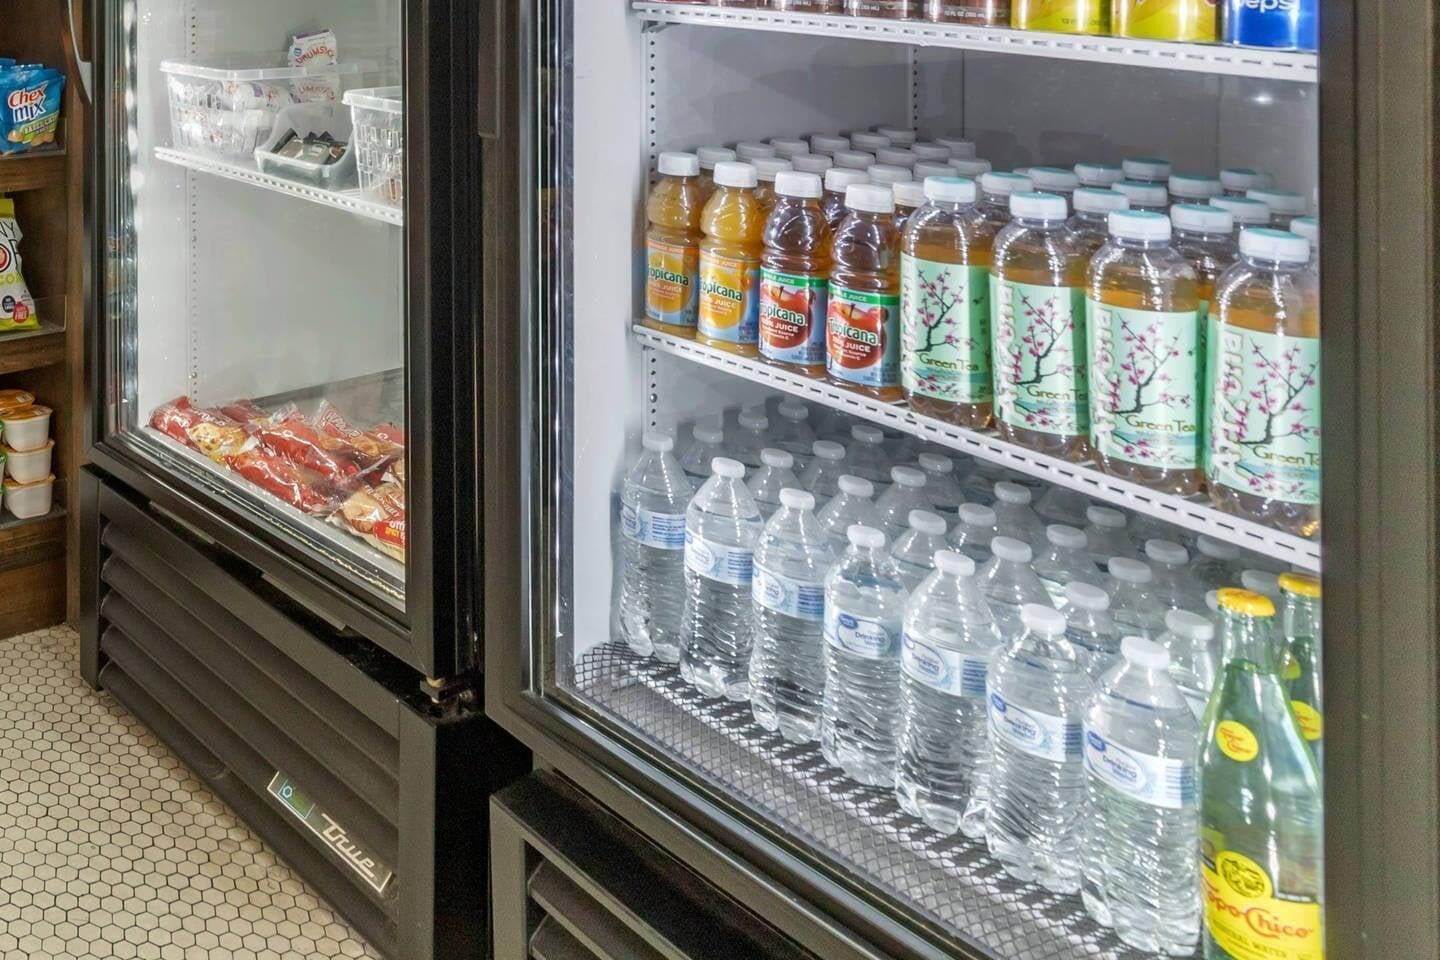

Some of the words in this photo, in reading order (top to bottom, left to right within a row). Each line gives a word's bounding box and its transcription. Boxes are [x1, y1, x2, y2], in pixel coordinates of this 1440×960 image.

[9, 90, 43, 107] Chex
[775, 324, 798, 332] JUICE
[846, 342, 871, 352] JUICE
[919, 352, 957, 369] Green
[1027, 385, 1070, 400] Green
[1126, 415, 1173, 432] Green
[1176, 419, 1196, 432] Tea
[1253, 445, 1305, 466] Green
